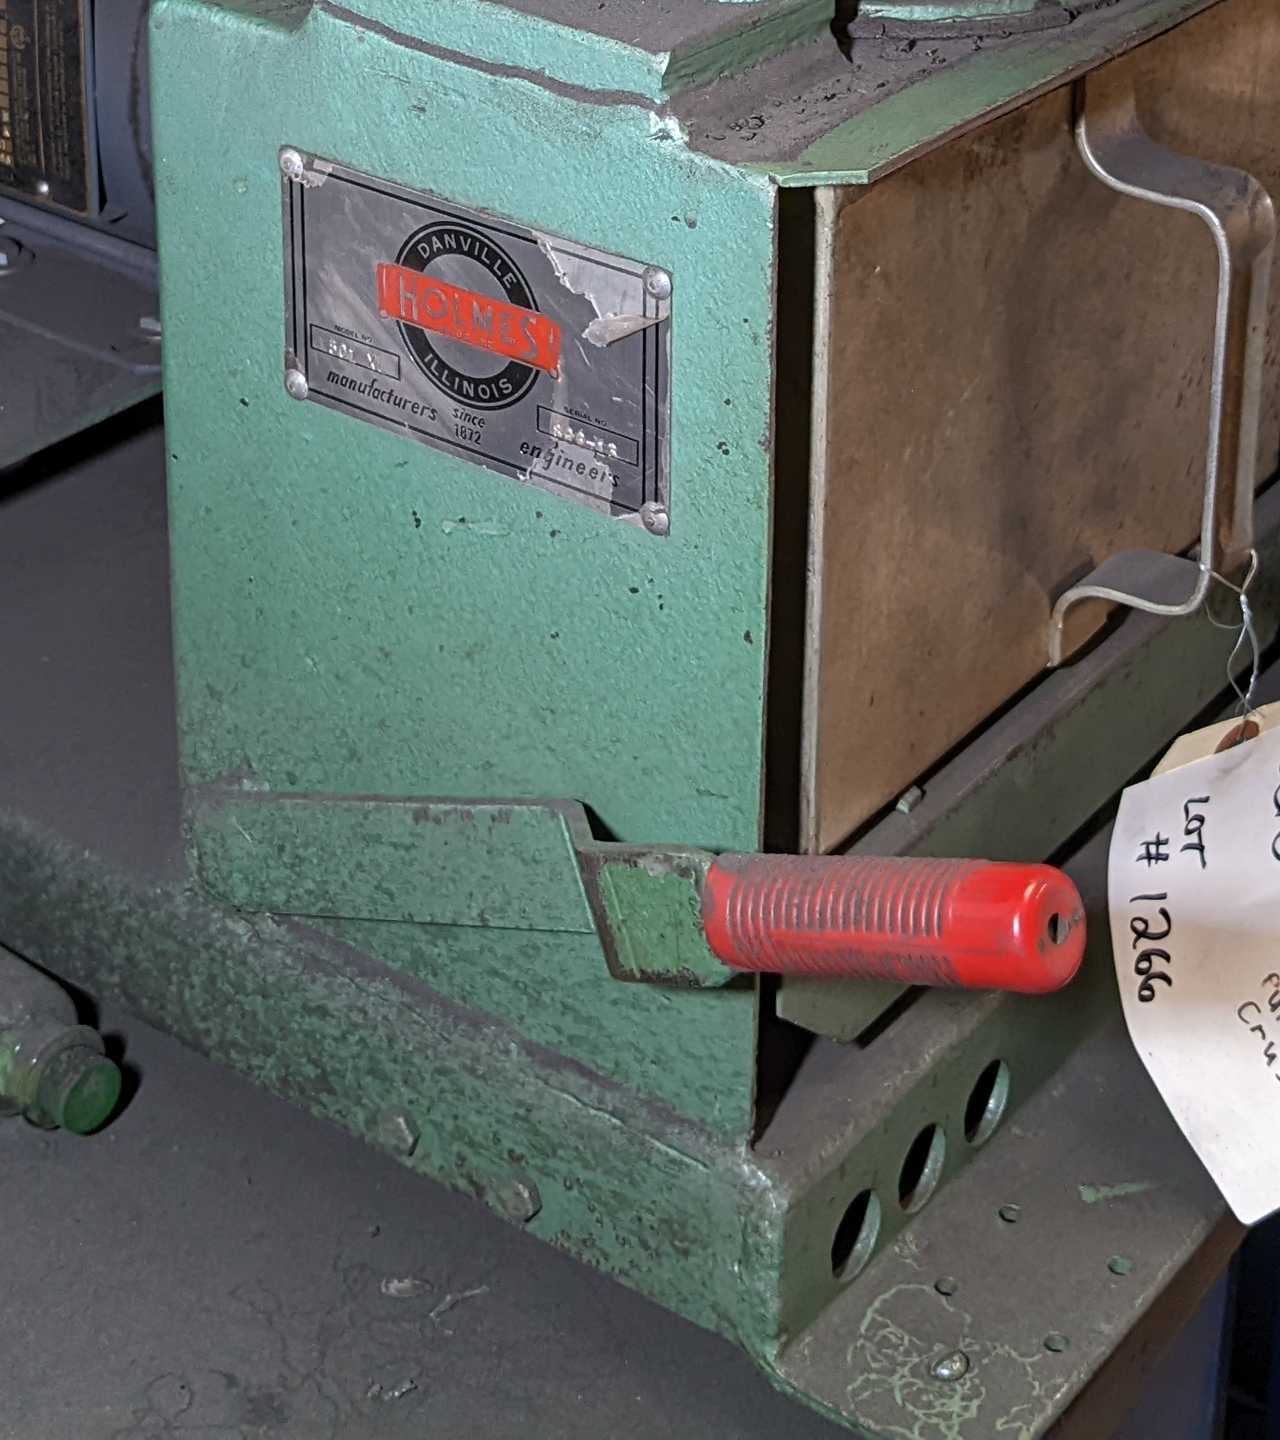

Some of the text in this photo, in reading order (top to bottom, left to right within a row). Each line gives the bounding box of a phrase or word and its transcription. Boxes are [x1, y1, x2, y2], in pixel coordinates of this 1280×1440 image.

[417, 233, 518, 288] DANVILLE
[399, 272, 541, 360] HOLMES
[327, 371, 439, 422] manufacturers
[423, 353, 513, 400] ILLINOIS
[452, 407, 486, 429] since
[454, 423, 483, 446] 1872
[520, 441, 621, 488] engineers
[1129, 891, 1173, 1003] 1266
